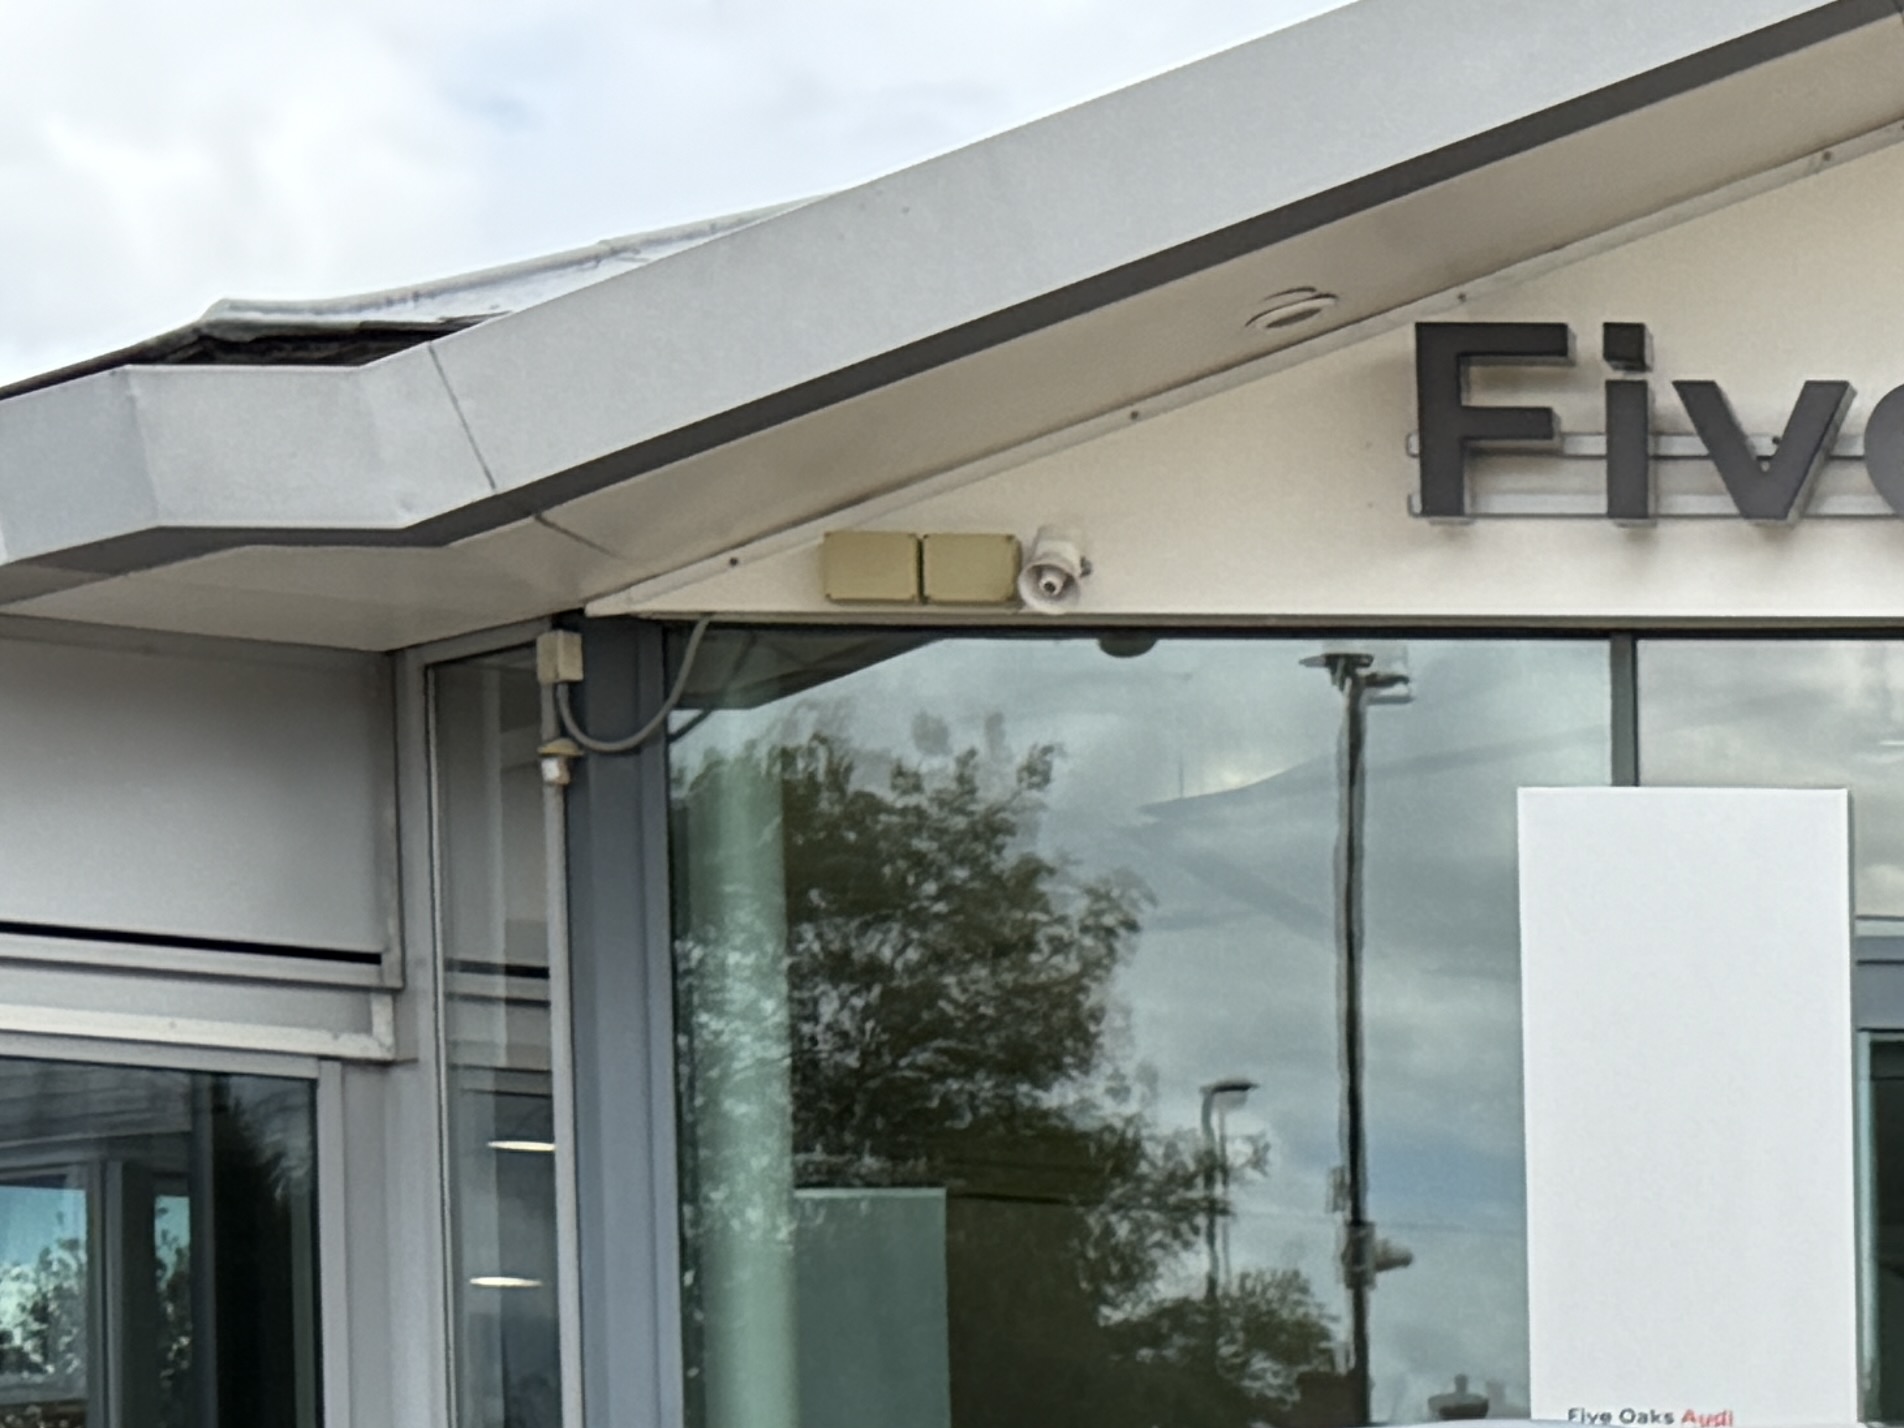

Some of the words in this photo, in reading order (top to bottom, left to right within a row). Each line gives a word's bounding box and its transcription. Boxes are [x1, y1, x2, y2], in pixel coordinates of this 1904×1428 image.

[1567, 1408, 1612, 1426] Five
[1619, 1408, 1674, 1426] Oaks
[1681, 1409, 1734, 1428] Audi
